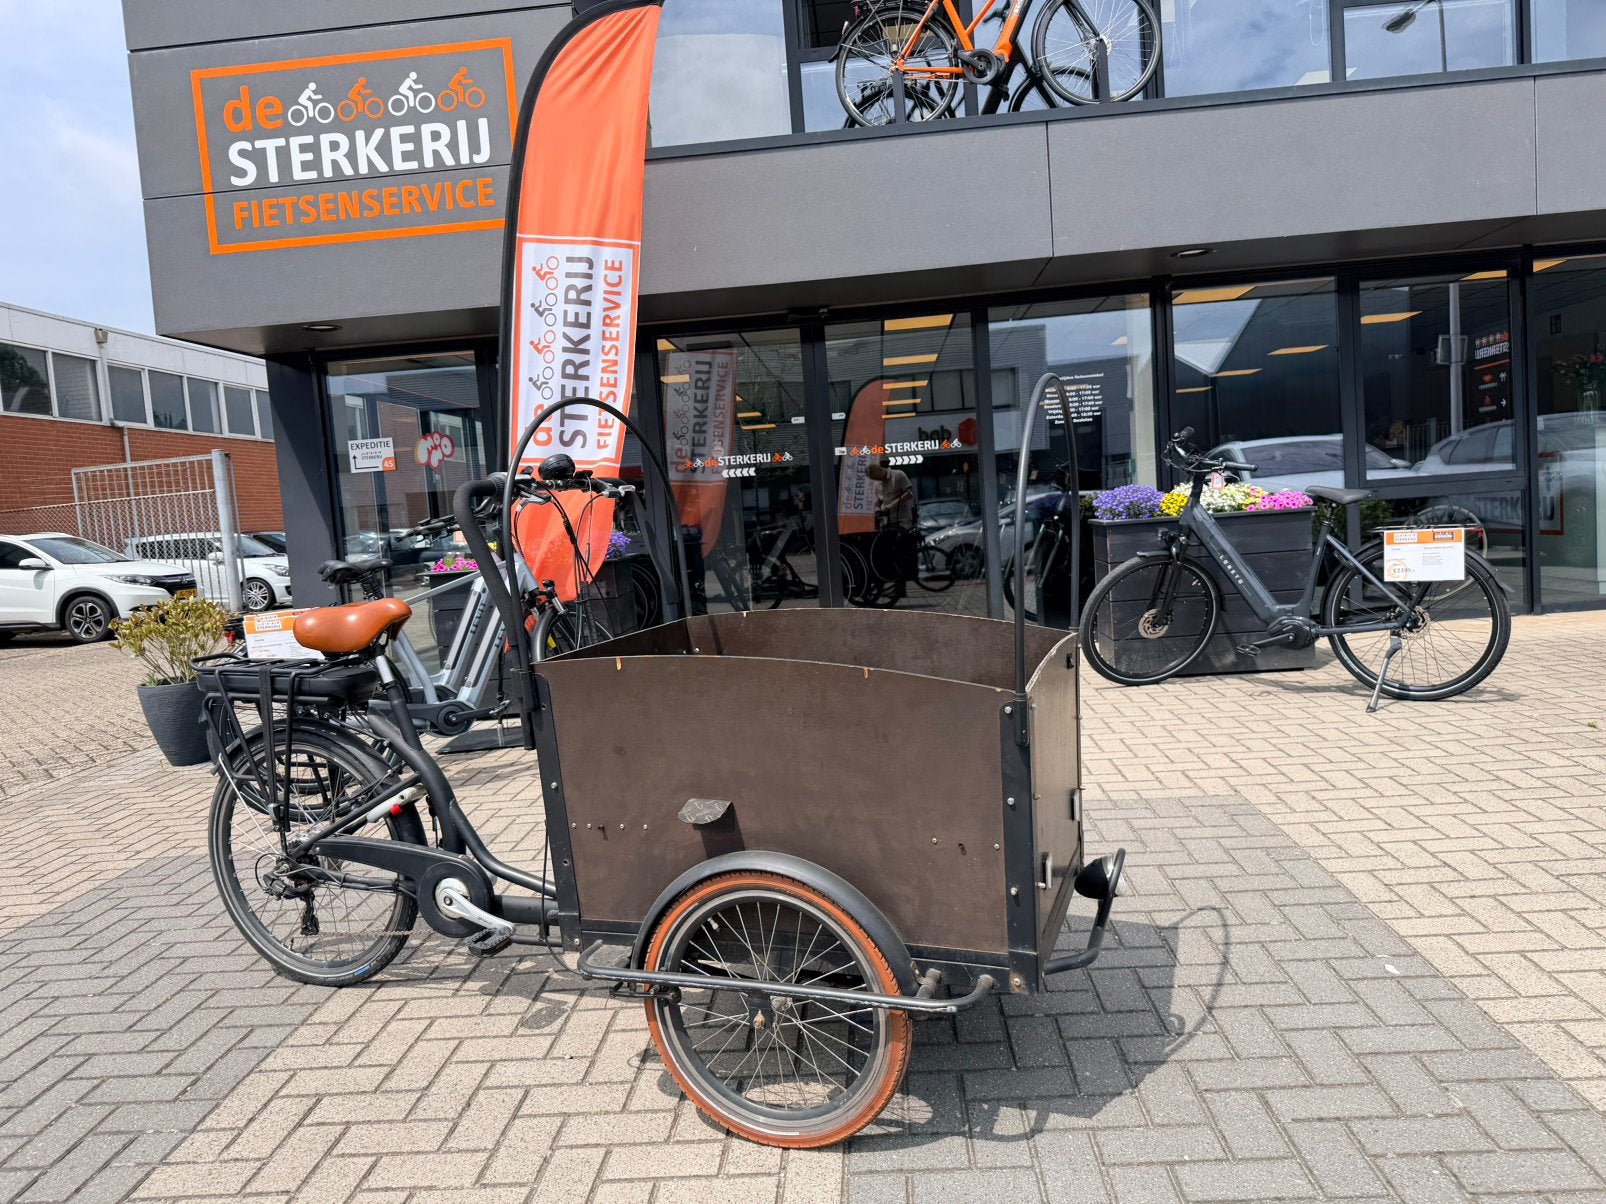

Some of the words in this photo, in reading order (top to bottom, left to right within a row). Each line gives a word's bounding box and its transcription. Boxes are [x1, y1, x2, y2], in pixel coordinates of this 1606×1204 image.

[223, 86, 283, 133] de
[228, 118, 492, 187] STERKERIJ
[233, 178, 496, 230] FIETSENSERVICE
[559, 256, 594, 449] STERKERIJ
[350, 440, 391, 451] EXPEDITIE
[718, 453, 771, 467] STERKERIJ
[884, 440, 939, 453] STERKERIJ
